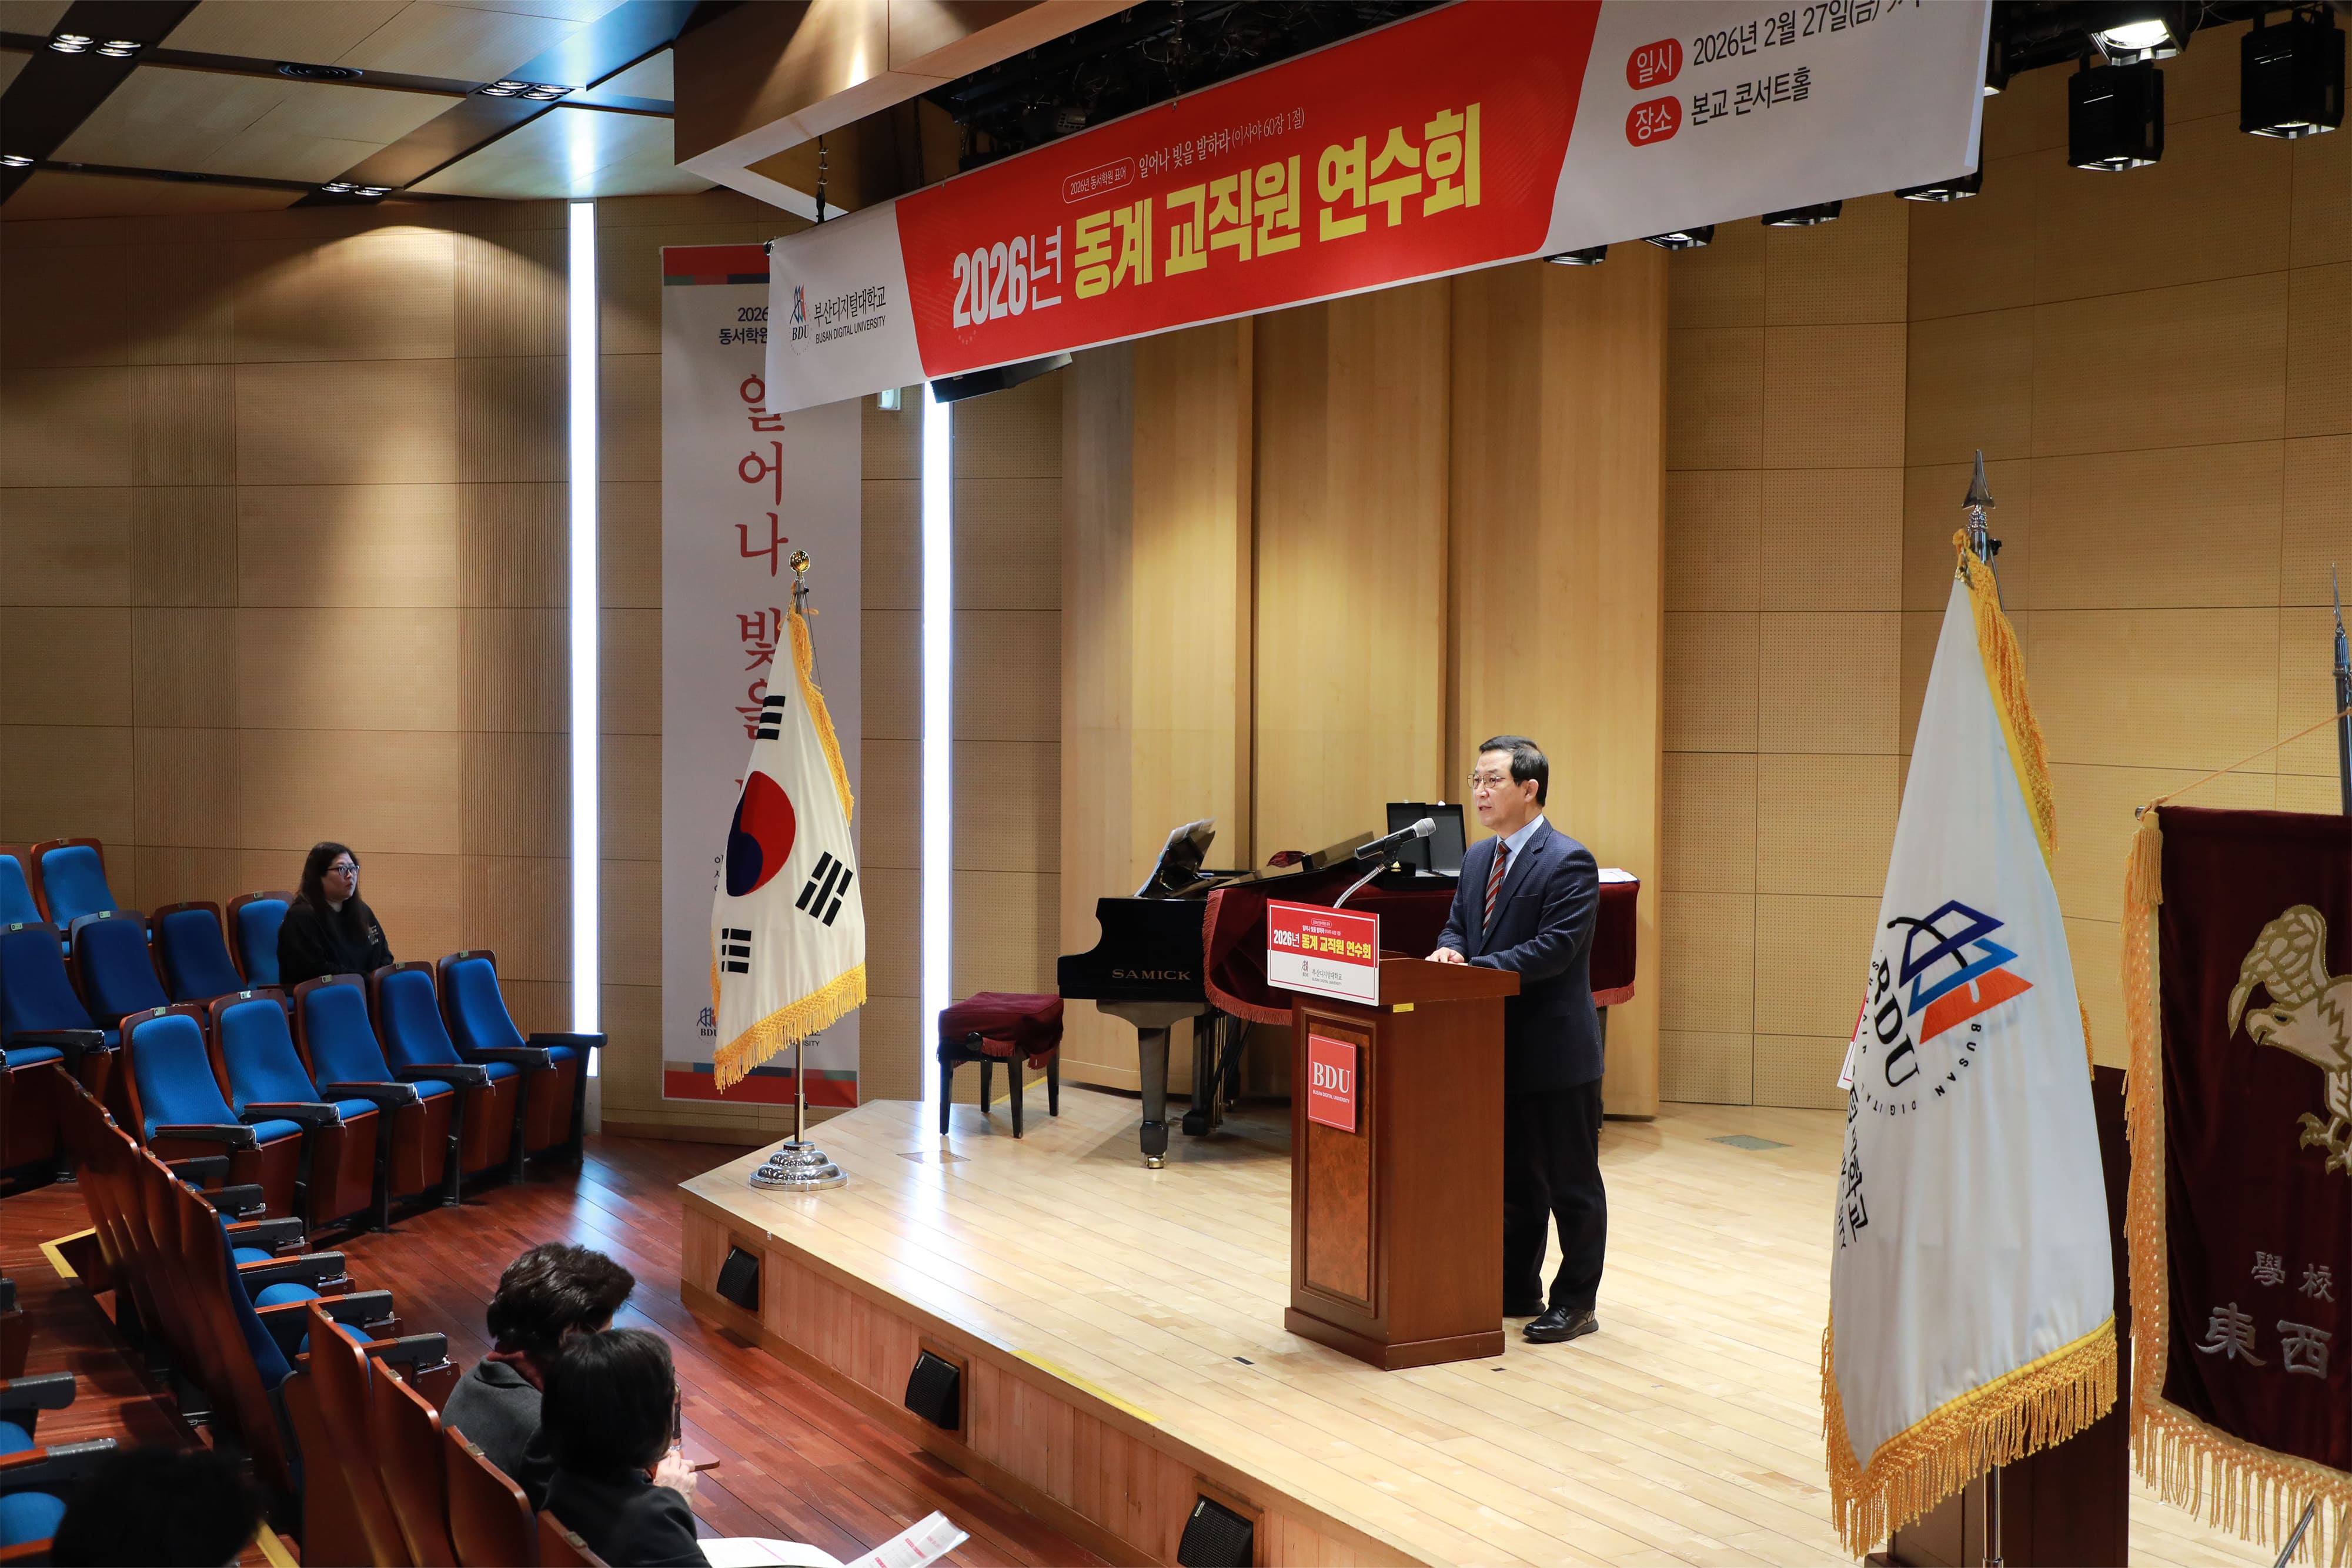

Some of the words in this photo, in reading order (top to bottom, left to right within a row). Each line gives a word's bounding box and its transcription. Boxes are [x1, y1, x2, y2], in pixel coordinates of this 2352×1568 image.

[1693, 21, 1757, 66] 2026년
[1763, 9, 1796, 48] 2월
[1636, 44, 1673, 83] 일시
[1691, 89, 1729, 126] 본교
[1734, 66, 1812, 116] 콘서트홀
[1635, 104, 1672, 141] 장소
[1139, 148, 1170, 178] 일어나
[1172, 140, 1194, 169] 빛을
[1197, 128, 1230, 160] 발하라
[1232, 119, 1262, 149] (이사야
[1263, 113, 1284, 138] 60장
[1287, 106, 1305, 131] 1절)
[1070, 179, 1090, 195] 2026년
[1091, 170, 1114, 190] 동서학원
[1114, 166, 1127, 182] 표어
[953, 225, 1062, 329] 2026년
[1074, 197, 1153, 300] 동계
[1165, 155, 1301, 276] 교직원
[1317, 102, 1481, 242] 연수회
[814, 286, 886, 327] 부산디지털대학교
[719, 327, 767, 345] 동서학원
[792, 324, 809, 341] BDU
[816, 330, 833, 344] BUSAN
[834, 325, 853, 339] DIGITAL
[854, 315, 886, 333] UNIVERSITY
[1274, 930, 1299, 947] 2026년
[1301, 933, 1318, 950] 동계
[1319, 935, 1344, 955] 교직원
[1347, 941, 1371, 959] 연수회
[1112, 969, 1191, 981] SAMICK
[1312, 1061, 1351, 1094] BDU
[1935, 1023, 1982, 1096] BUSAN
[1323, 1092, 1334, 1100] DIGITAL
[1334, 1095, 1350, 1104] UNIVERSITY
[2251, 1251, 2335, 1303] 學校
[2194, 1302, 2333, 1379] 東西
